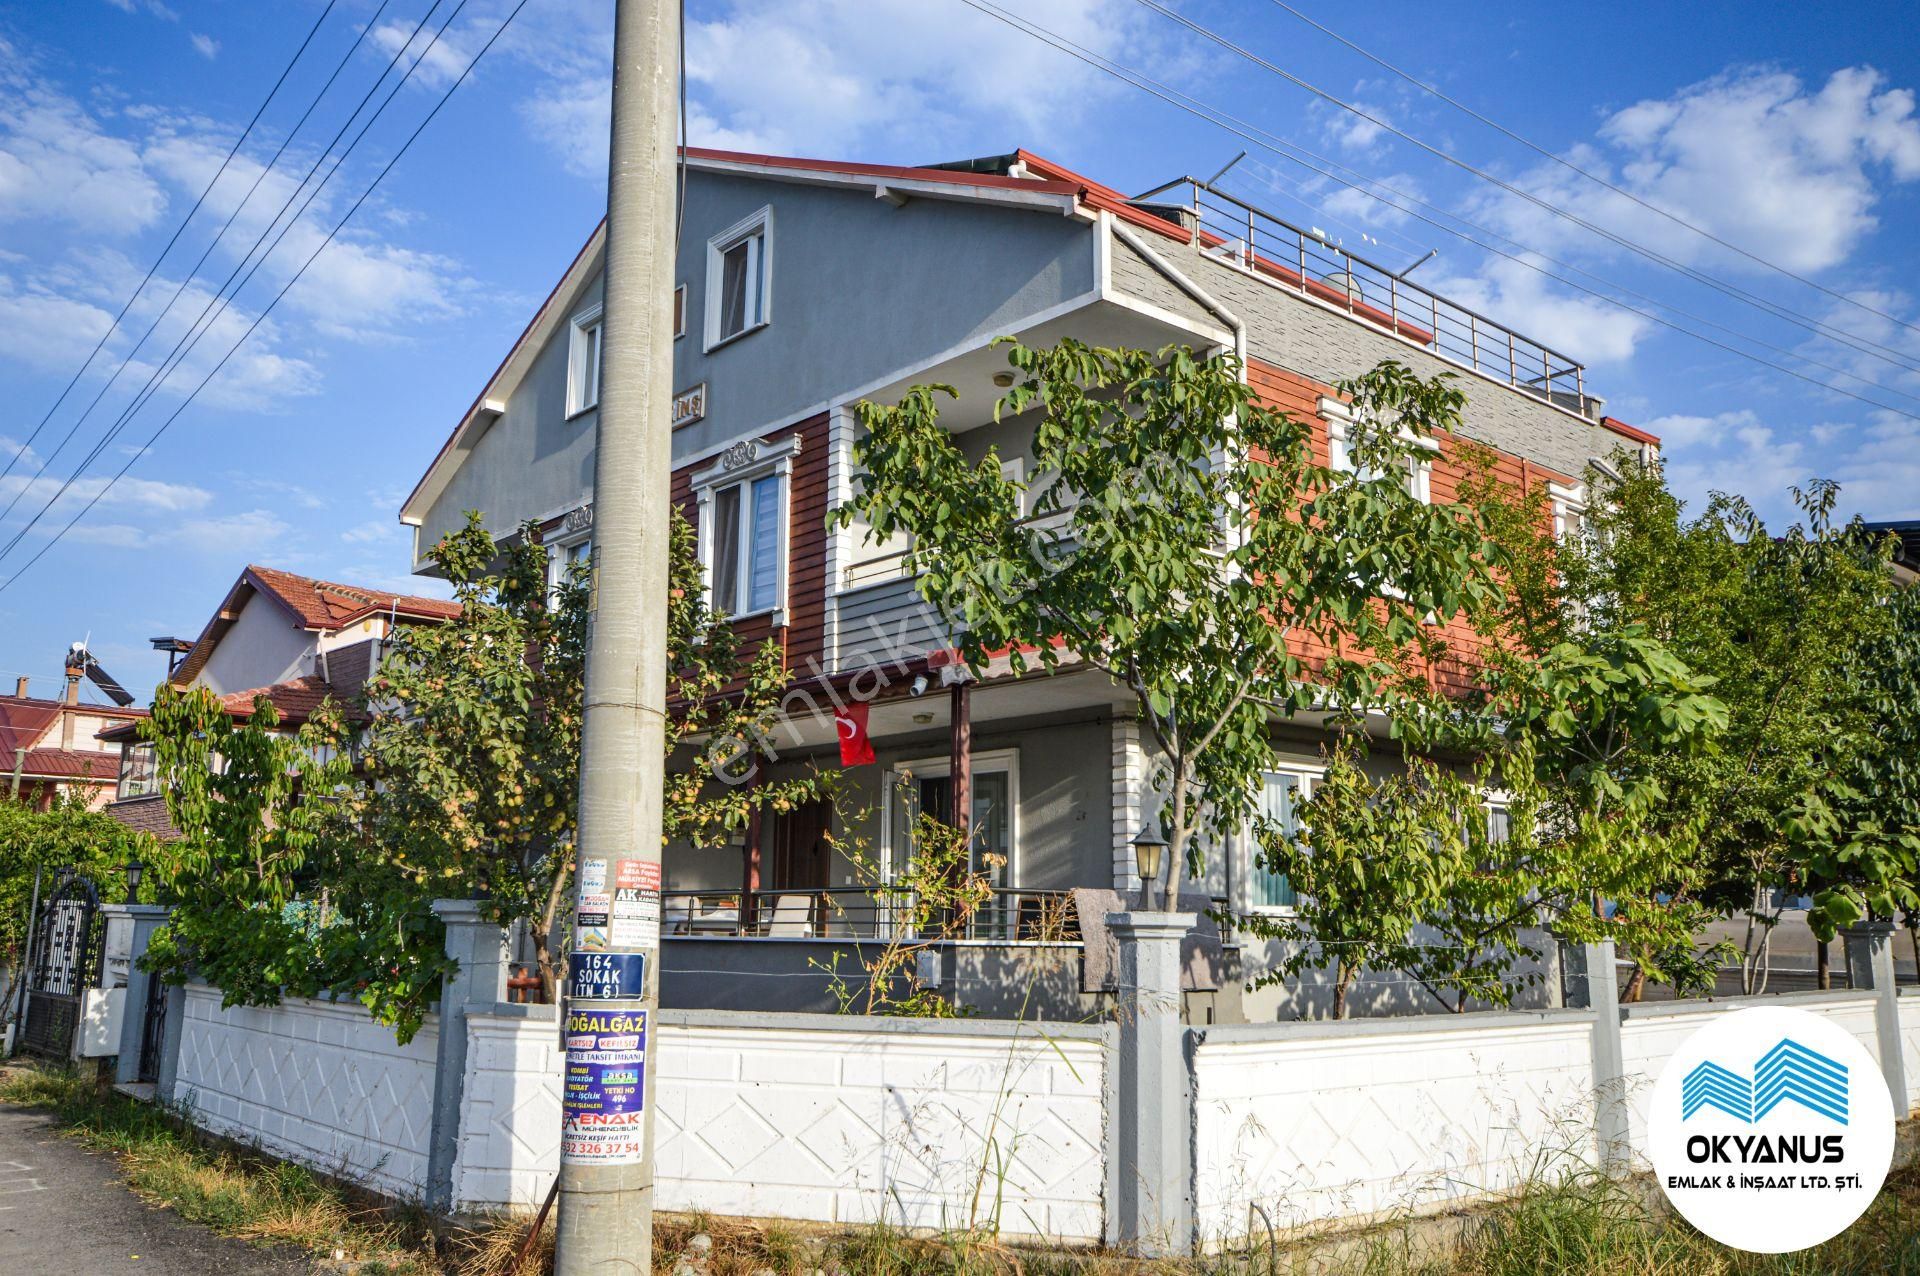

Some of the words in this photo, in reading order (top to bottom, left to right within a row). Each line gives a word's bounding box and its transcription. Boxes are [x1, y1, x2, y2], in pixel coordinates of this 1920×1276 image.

[616, 889, 638, 901] AK
[585, 955, 612, 969] 164
[578, 969, 621, 984] SOKAK
[612, 1094, 627, 1103] 496
[580, 1113, 640, 1125] ENAK
[579, 1143, 602, 1154] 326
[605, 1143, 621, 1154] 37
[625, 1142, 639, 1153] 54
